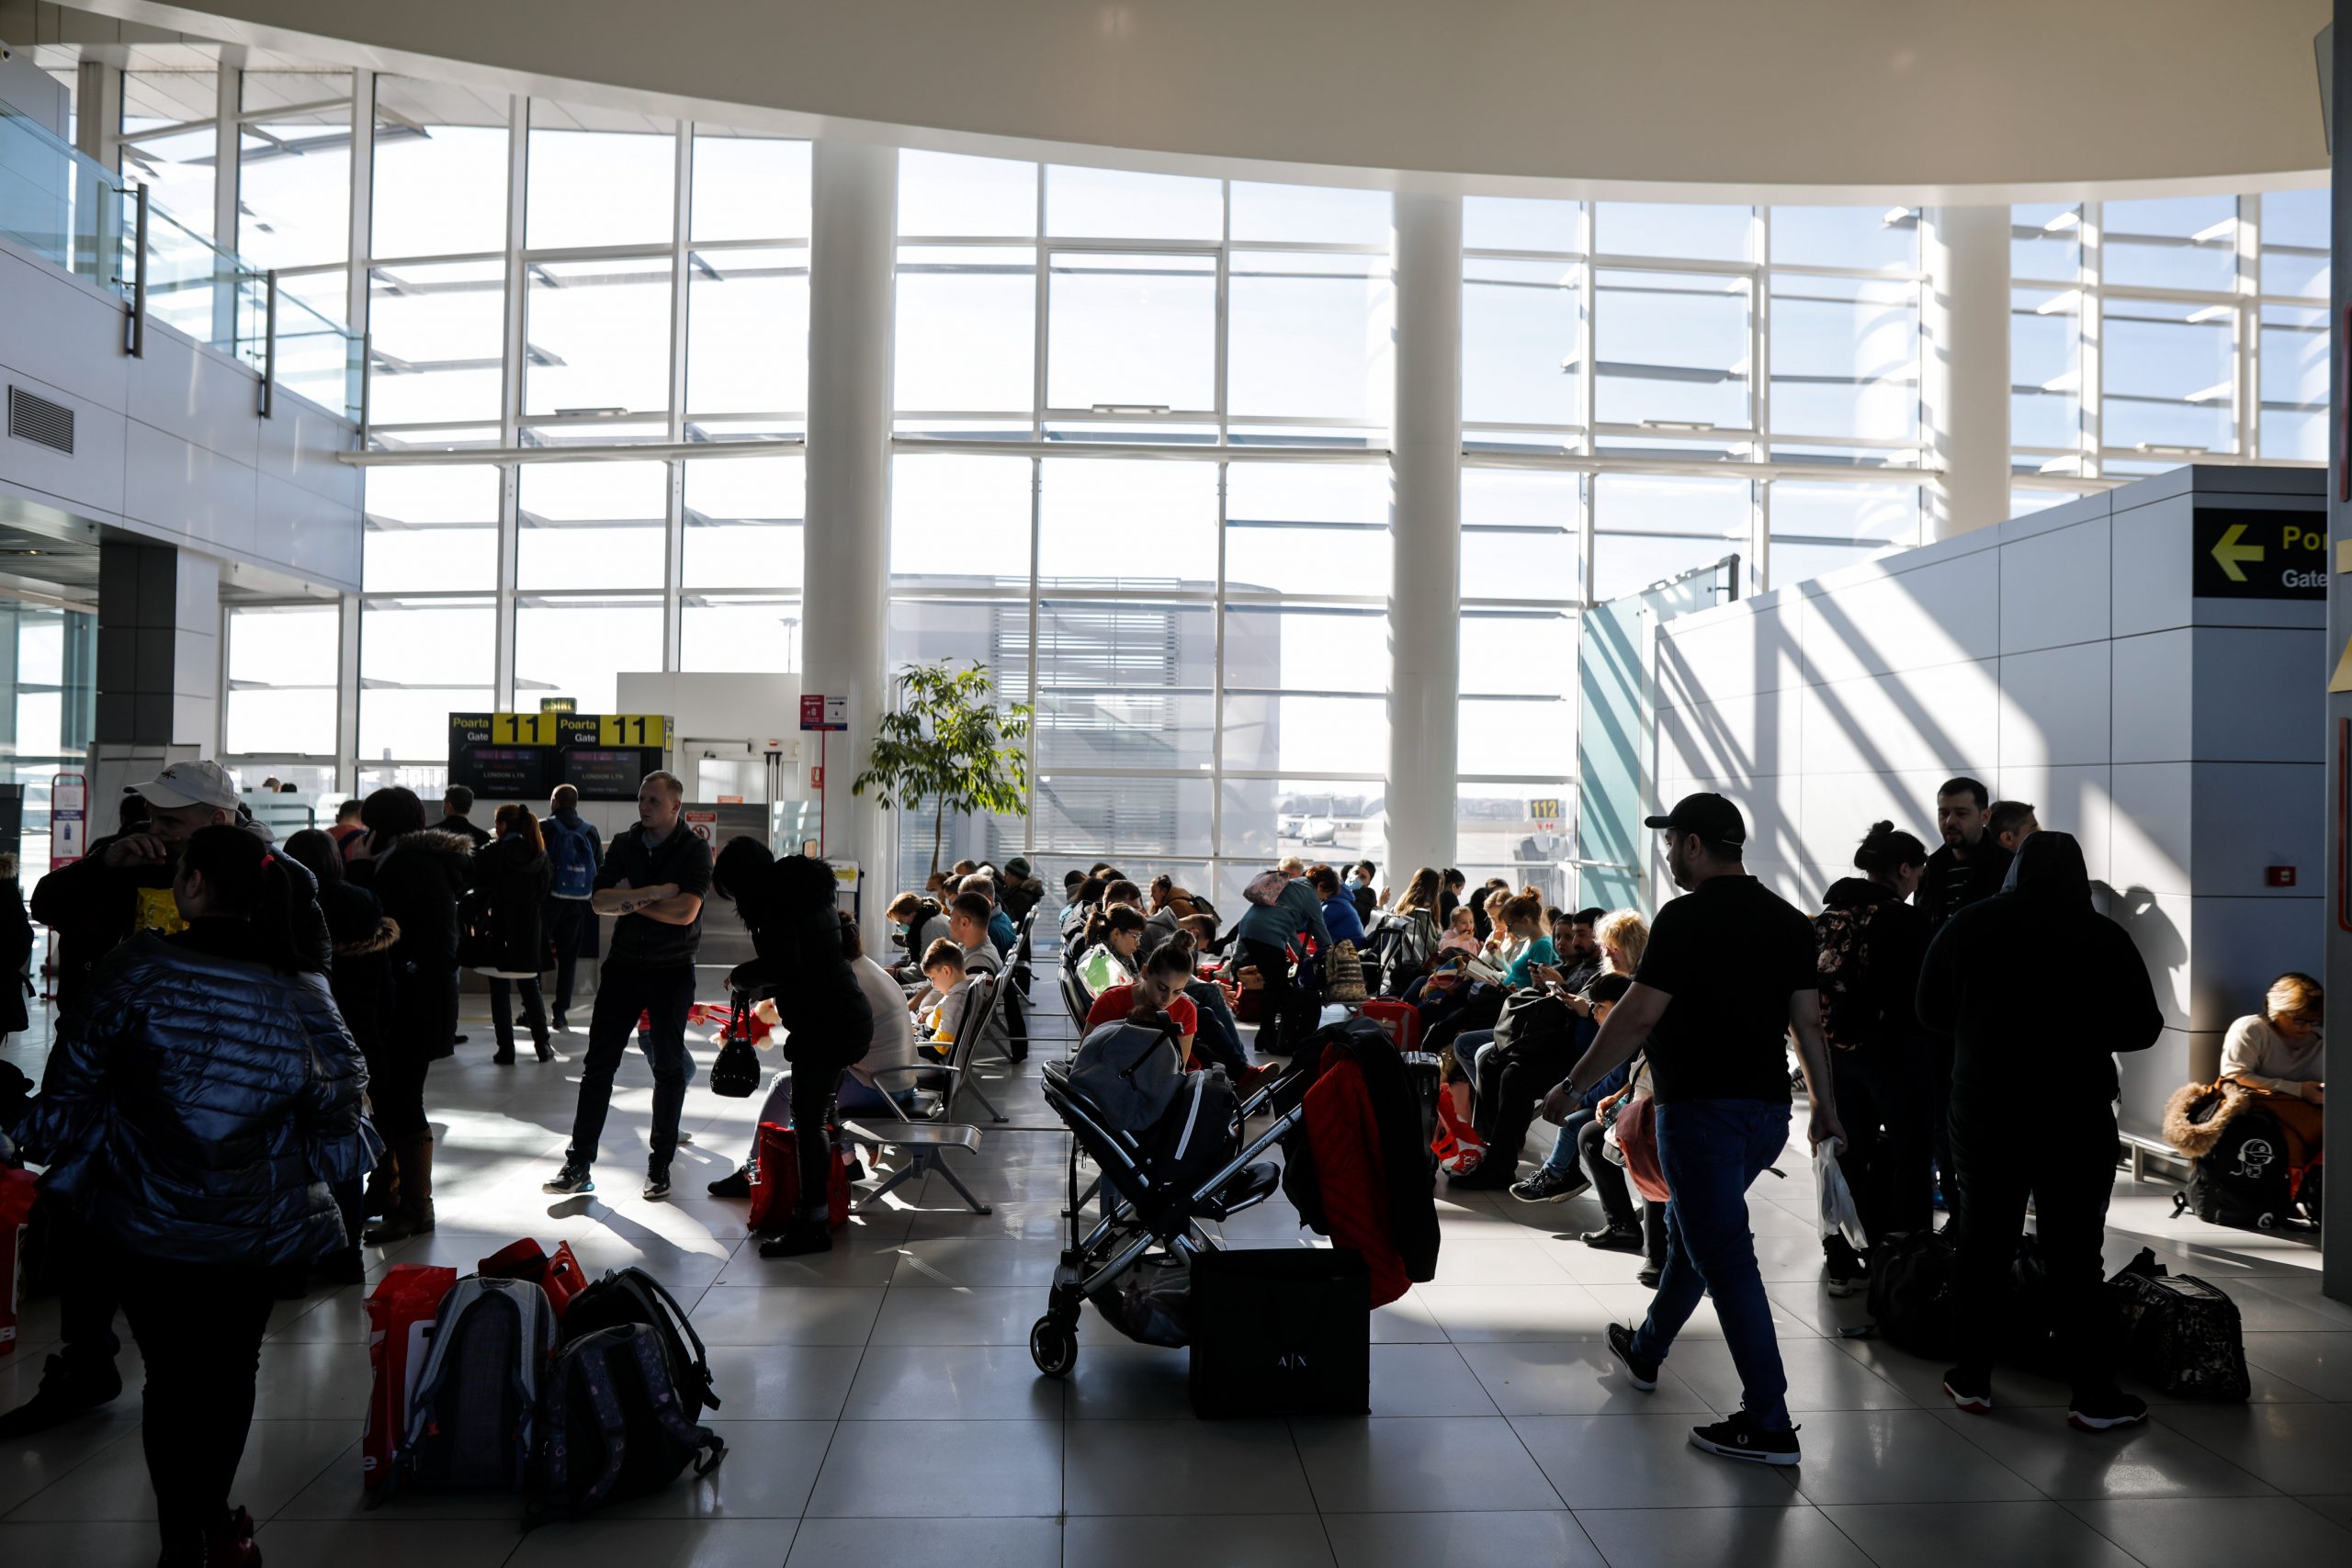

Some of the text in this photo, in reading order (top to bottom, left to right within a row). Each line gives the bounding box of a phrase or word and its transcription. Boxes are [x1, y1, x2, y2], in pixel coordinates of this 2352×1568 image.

[453, 718, 489, 728] Poarta
[560, 719, 596, 730] Poarta
[506, 716, 538, 743] 11
[613, 716, 646, 744] 11
[467, 732, 489, 741] Gate
[575, 734, 596, 743] Gate
[1532, 800, 1557, 818] 112
